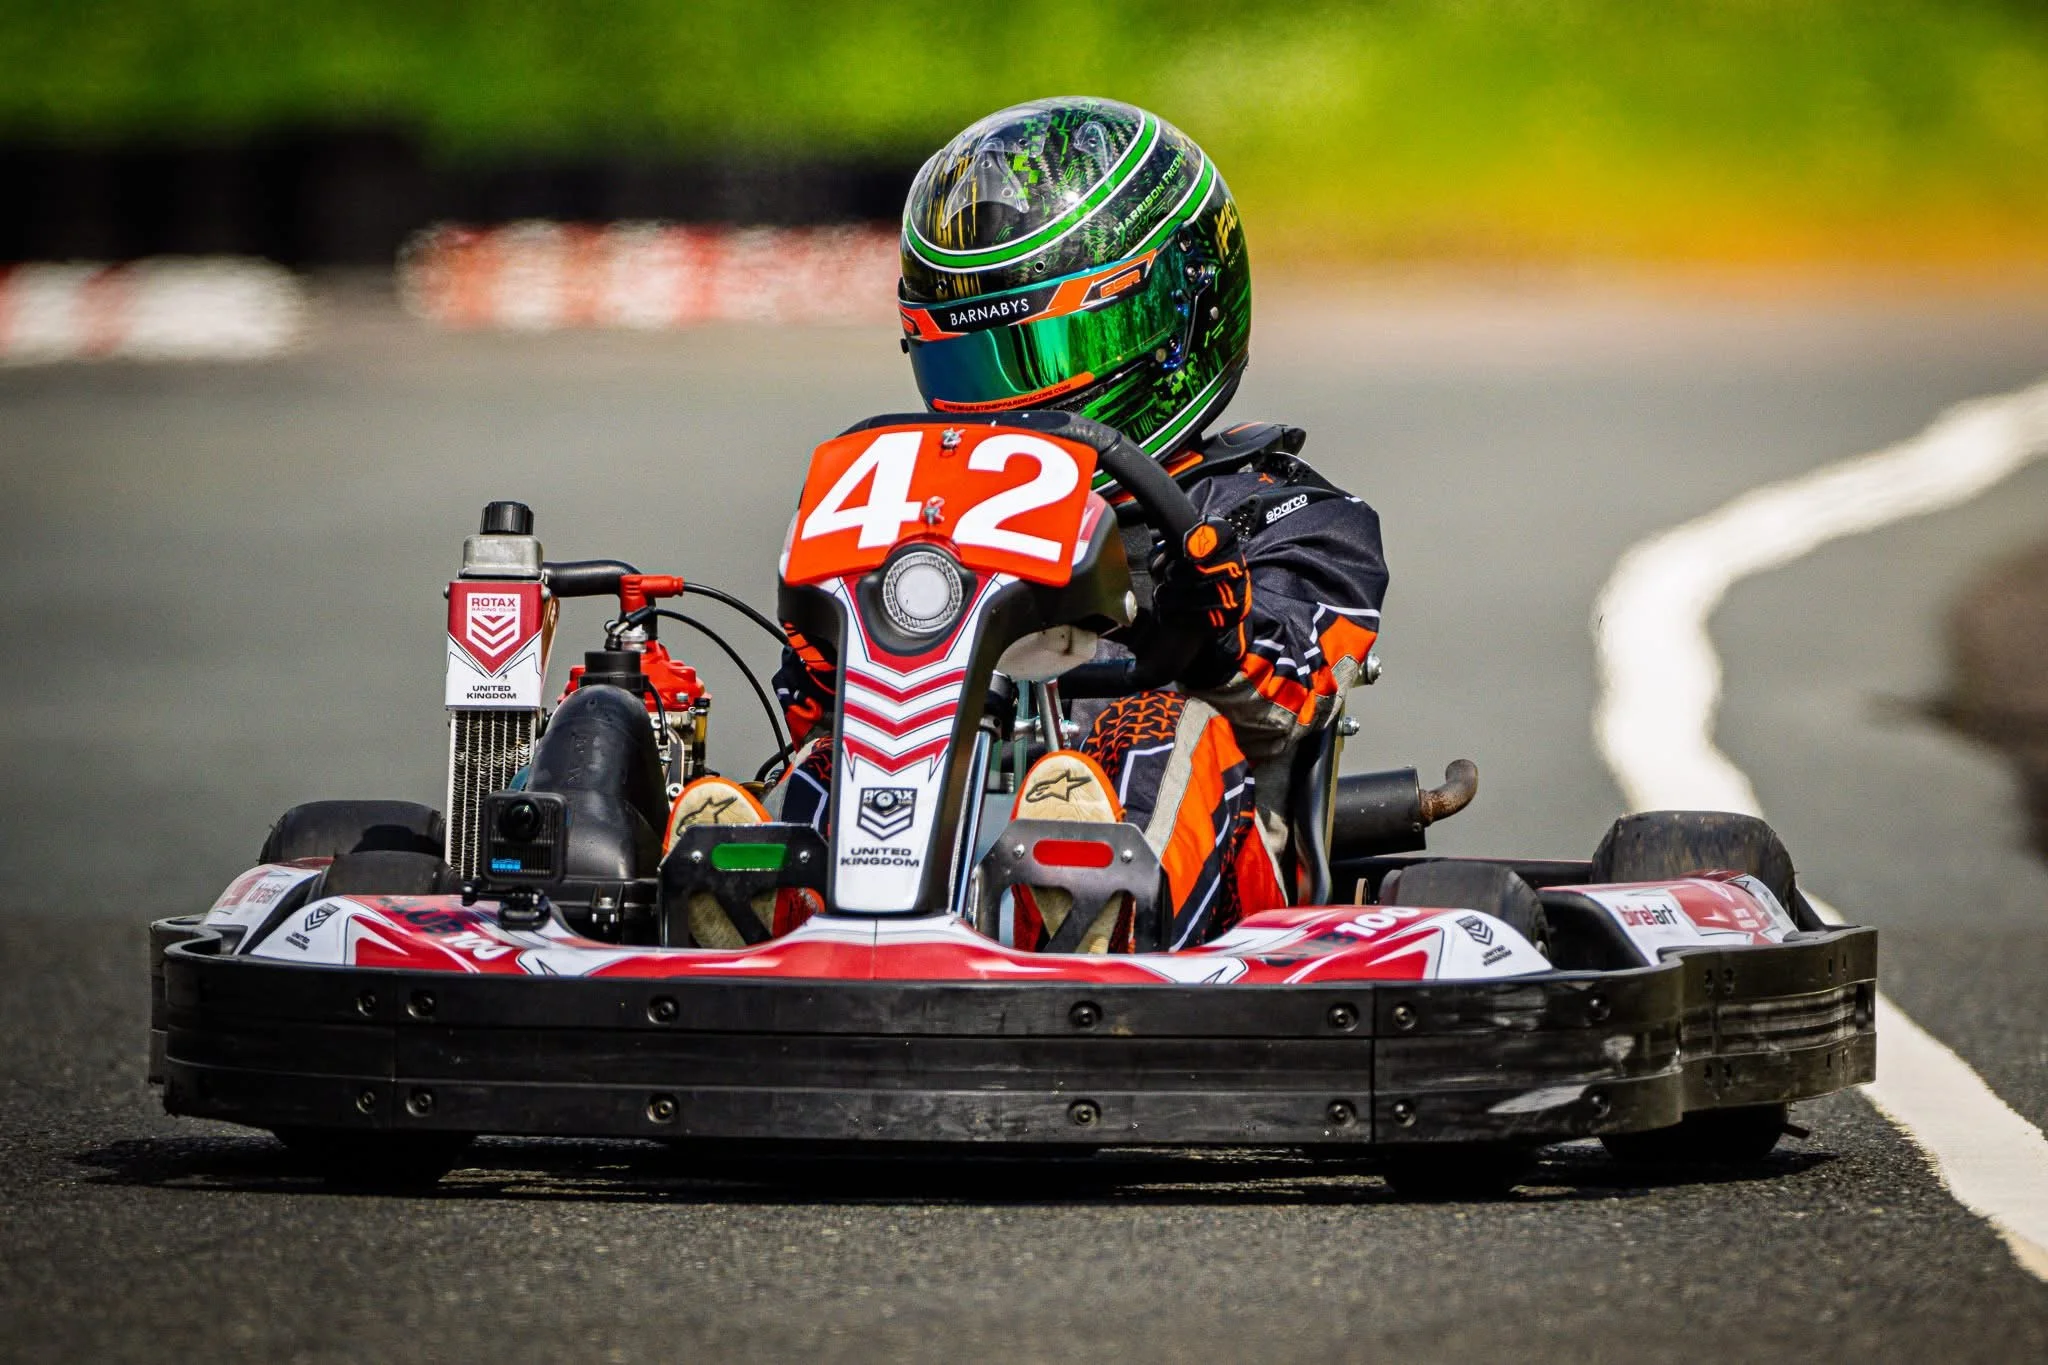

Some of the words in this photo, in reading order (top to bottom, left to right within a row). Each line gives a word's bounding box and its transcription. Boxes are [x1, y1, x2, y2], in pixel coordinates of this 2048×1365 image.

[950, 298, 1029, 326] BARNABYS
[801, 430, 1080, 563] 42
[1266, 494, 1308, 522] sparco
[472, 597, 516, 607] ROTAX
[840, 857, 920, 868] KINGDOM
[850, 847, 912, 856] UNITED
[1335, 906, 1422, 938] 100
